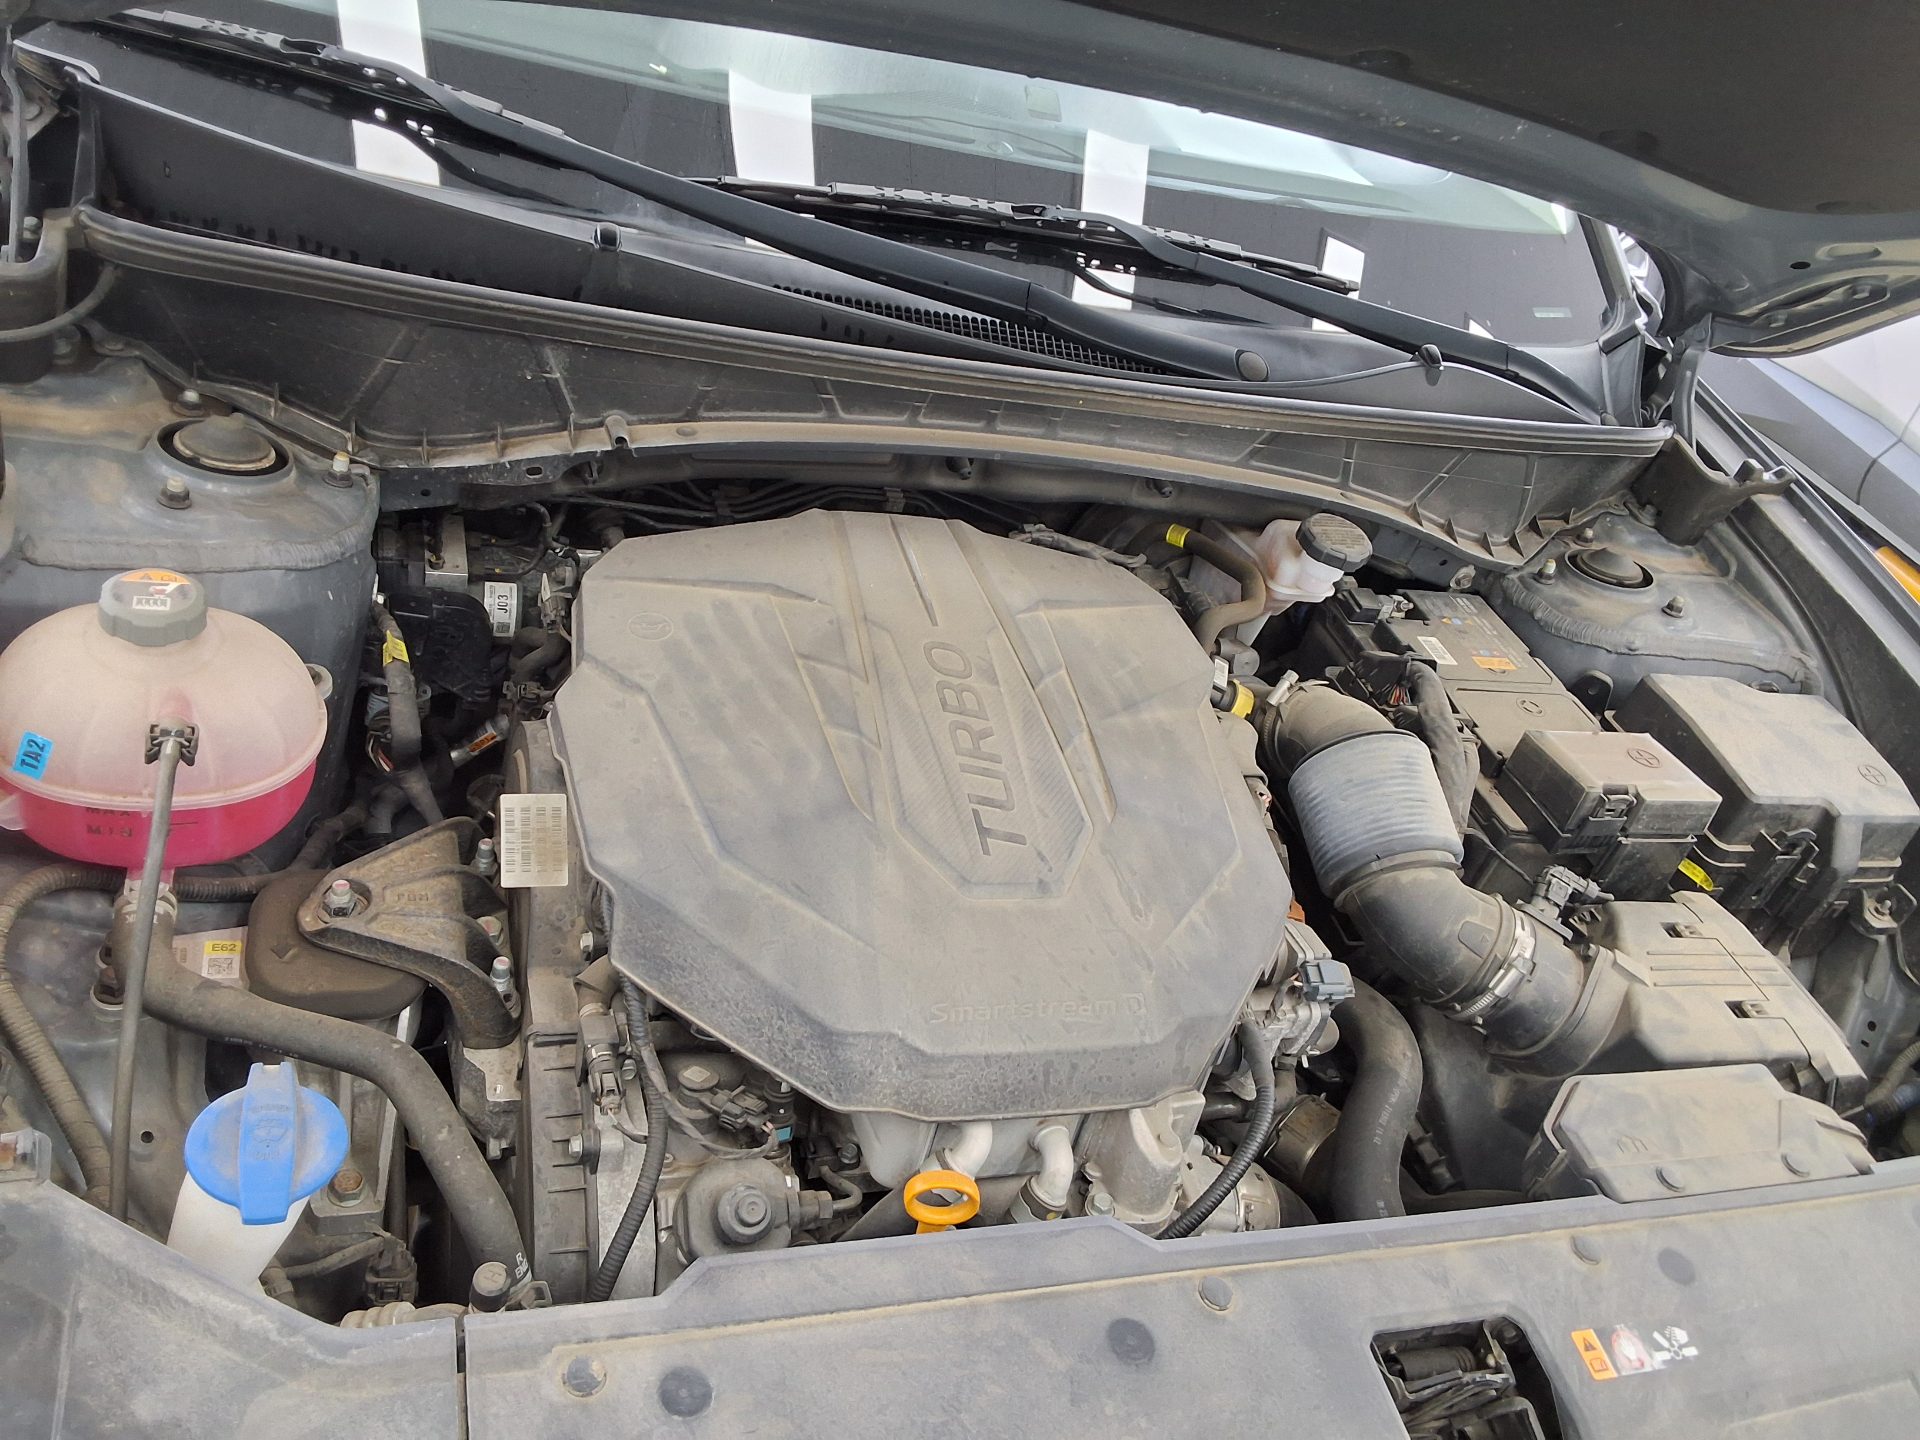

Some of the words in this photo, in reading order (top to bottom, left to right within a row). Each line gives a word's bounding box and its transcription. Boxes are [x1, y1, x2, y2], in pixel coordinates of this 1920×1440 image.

[497, 594, 509, 614] J03
[20, 738, 47, 770] TA2
[922, 640, 1028, 857] TURBO
[211, 943, 237, 952] E62
[929, 998, 1120, 1024] Smartstream
